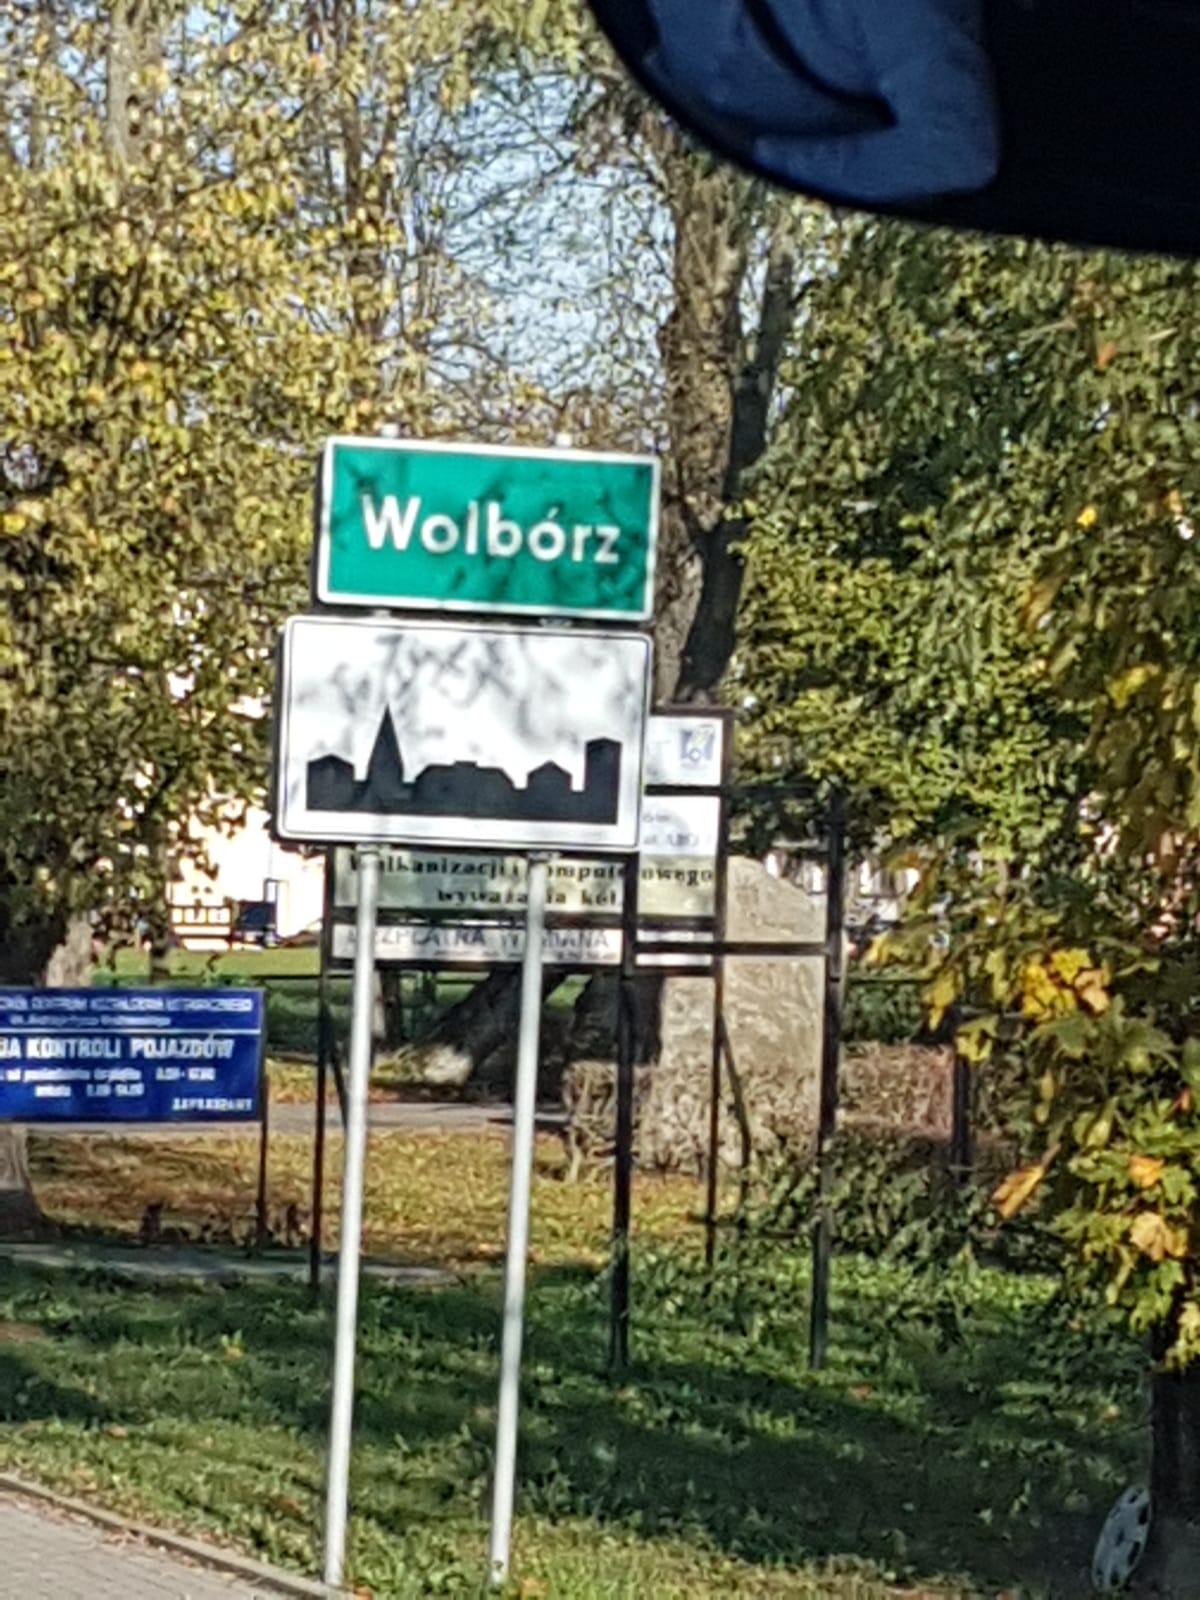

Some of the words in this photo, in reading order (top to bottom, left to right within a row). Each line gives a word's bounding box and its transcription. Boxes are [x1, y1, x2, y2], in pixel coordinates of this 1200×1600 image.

[361, 494, 622, 563] Wolbórz
[26, 1036, 121, 1059] KONTROLI
[130, 1033, 235, 1059] POJAZDÓW
